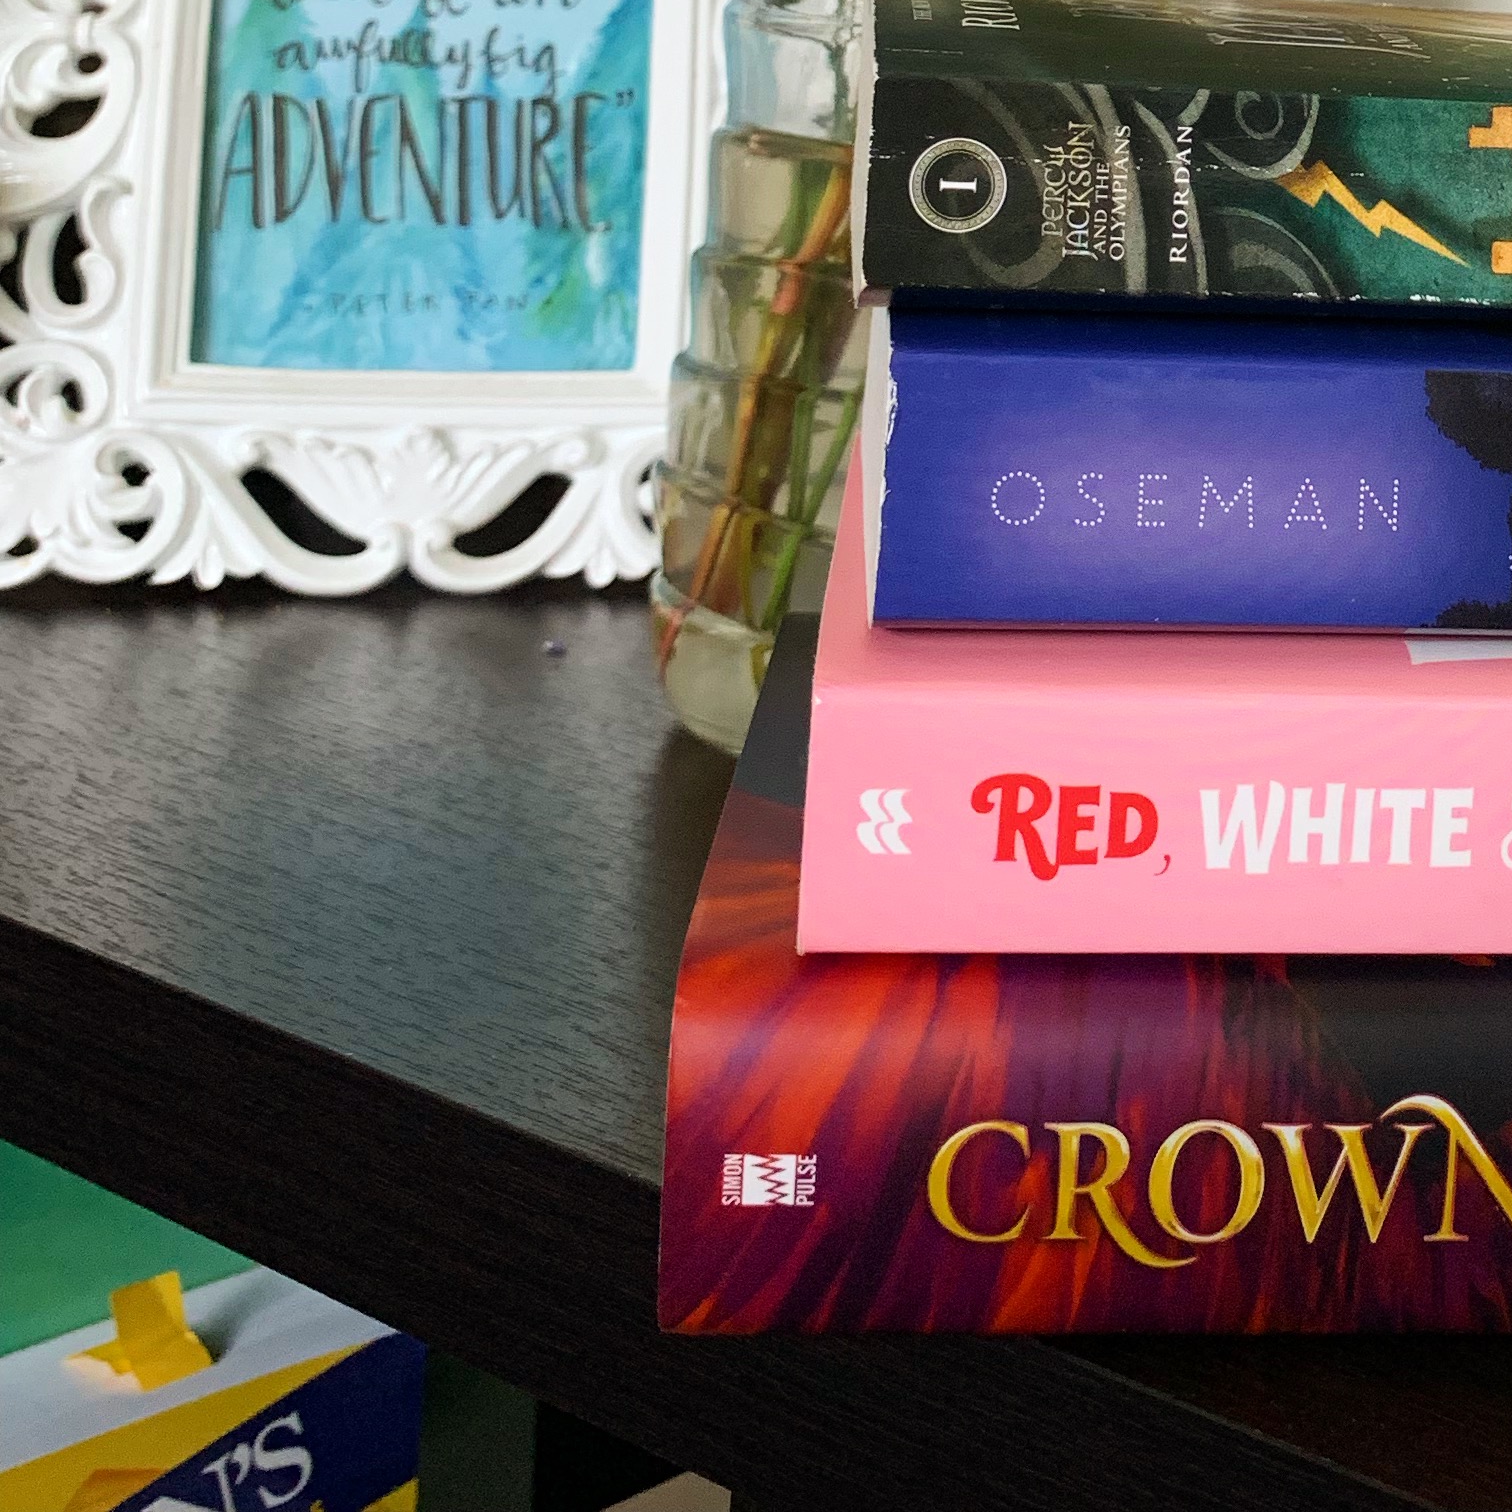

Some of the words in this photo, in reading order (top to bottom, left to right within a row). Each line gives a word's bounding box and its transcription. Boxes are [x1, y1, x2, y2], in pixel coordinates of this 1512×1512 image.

[272, 19, 471, 93] awfully
[482, 25, 565, 95] big
[1041, 144, 1067, 238] PERCY
[1062, 120, 1099, 262] JACKSON
[1094, 162, 1110, 203] THE
[1108, 124, 1131, 262] OLYMPIANS
[1168, 125, 1194, 264] RIORDAN
[1092, 208, 1108, 254] AND
[990, 471, 1400, 532] OSEMAN
[970, 772, 1172, 882] RED,
[1200, 780, 1475, 875] WHITE
[721, 1153, 743, 1206] SIMON
[795, 1154, 818, 1206] PULSE
